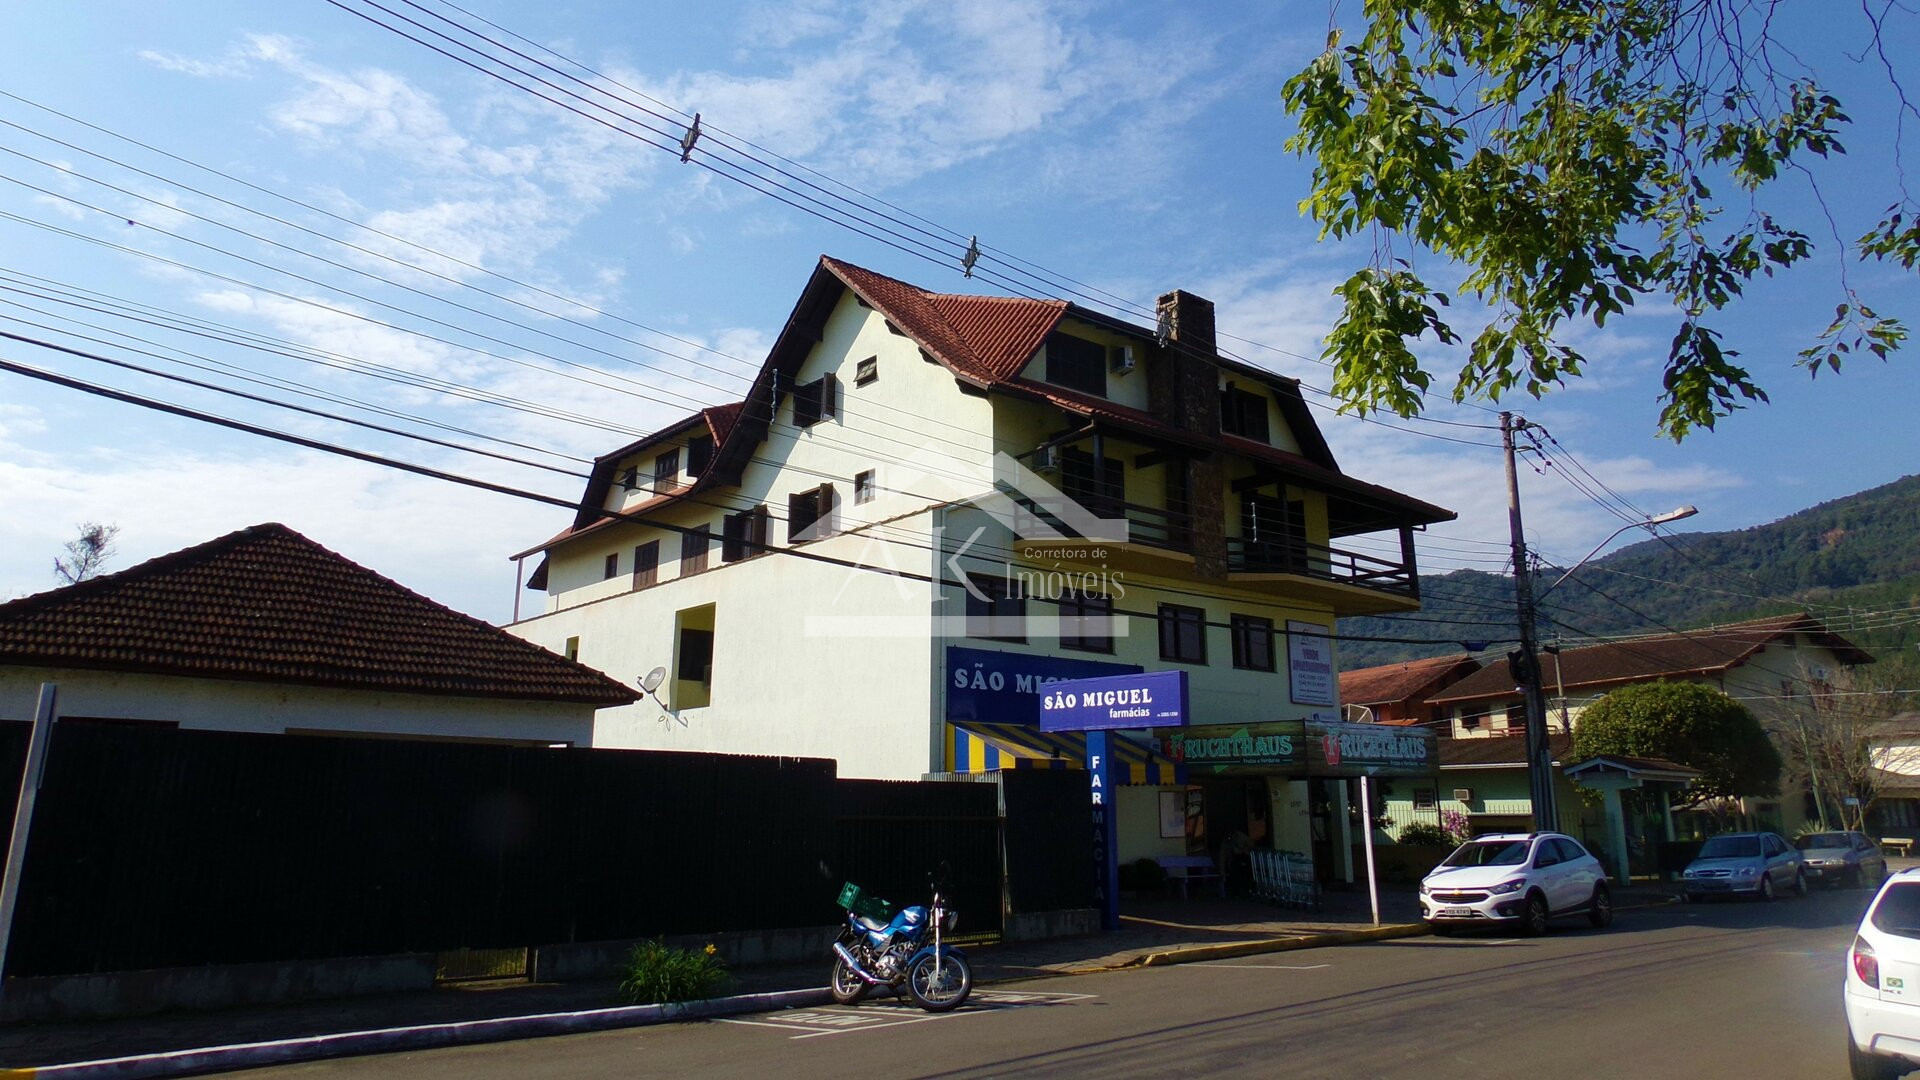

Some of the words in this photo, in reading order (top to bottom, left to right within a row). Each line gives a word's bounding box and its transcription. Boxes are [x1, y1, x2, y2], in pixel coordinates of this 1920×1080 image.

[954, 663, 1005, 691] SÃO
[1044, 691, 1077, 710] SÃO
[1083, 688, 1152, 708] MIGUEL
[1109, 707, 1150, 718] farmácias
